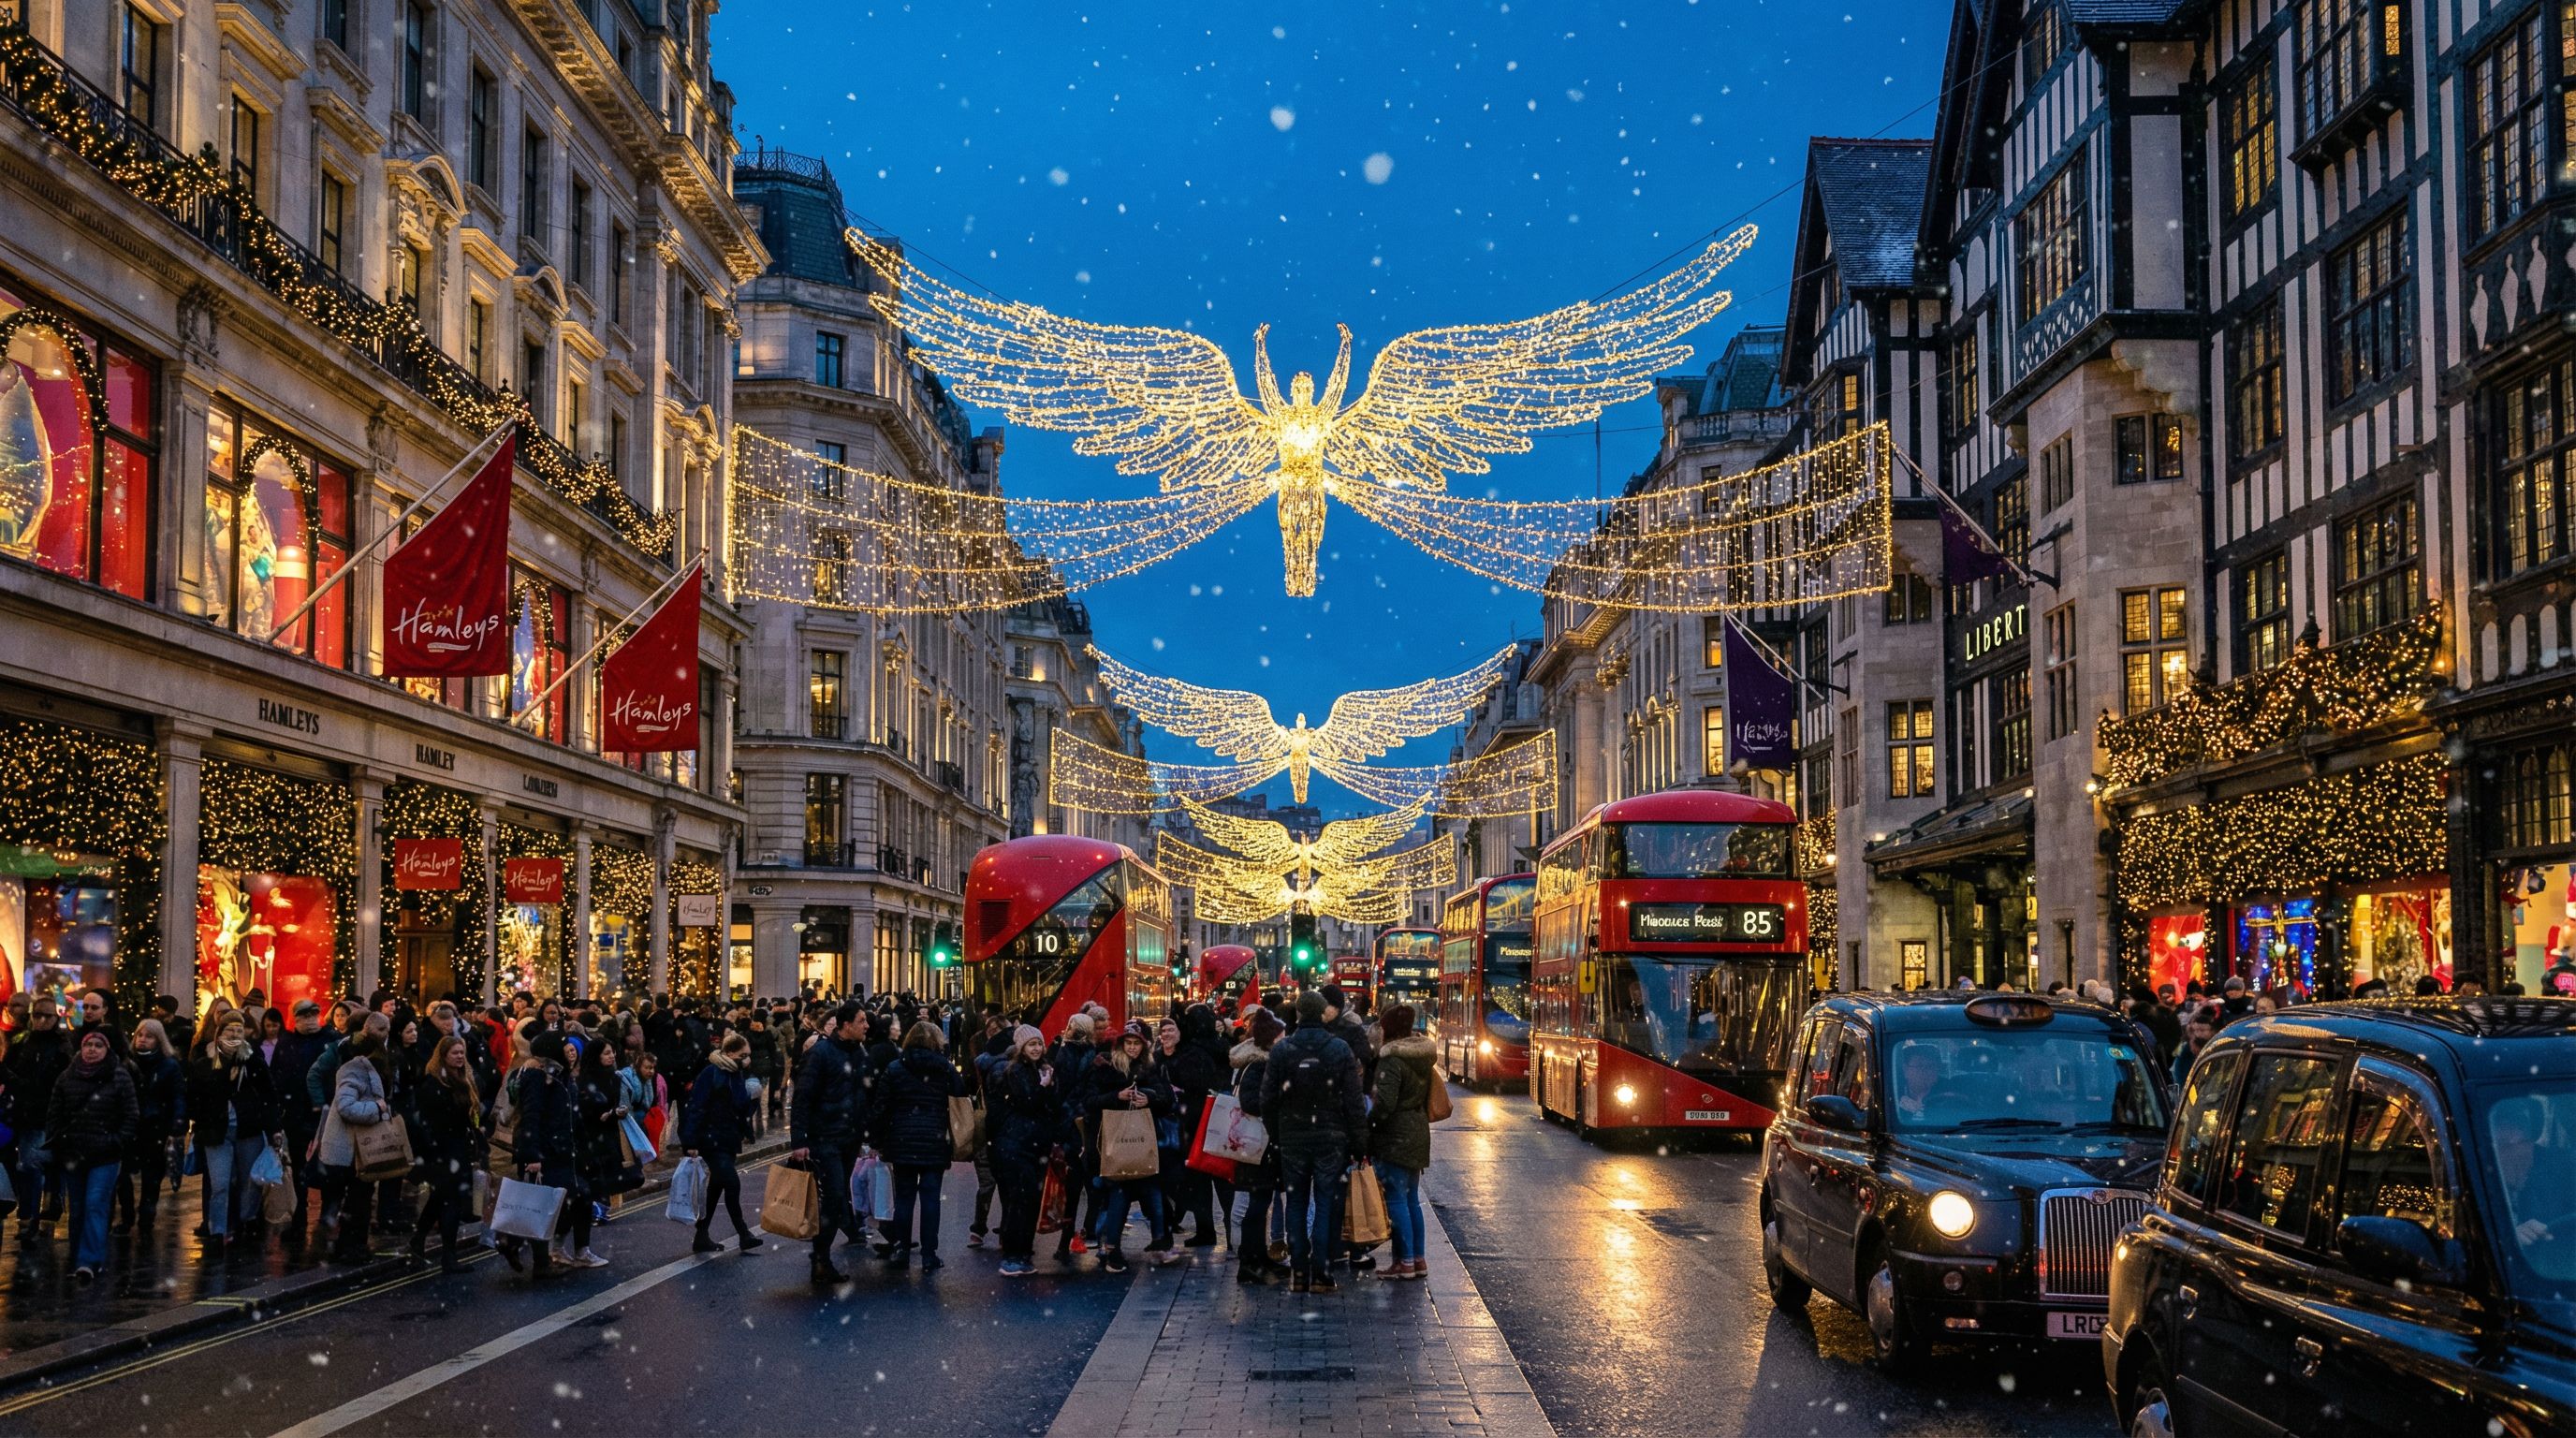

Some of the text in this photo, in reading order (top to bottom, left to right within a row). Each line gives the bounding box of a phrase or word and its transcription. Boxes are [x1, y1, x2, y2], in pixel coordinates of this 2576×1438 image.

[391, 597, 499, 652] Hamleys
[1967, 604, 2025, 661] LIBERT
[259, 697, 320, 735] HAMLEYS
[609, 689, 691, 731] Hamleys
[1743, 911, 1772, 934] 85
[1035, 934, 1058, 953] 10
